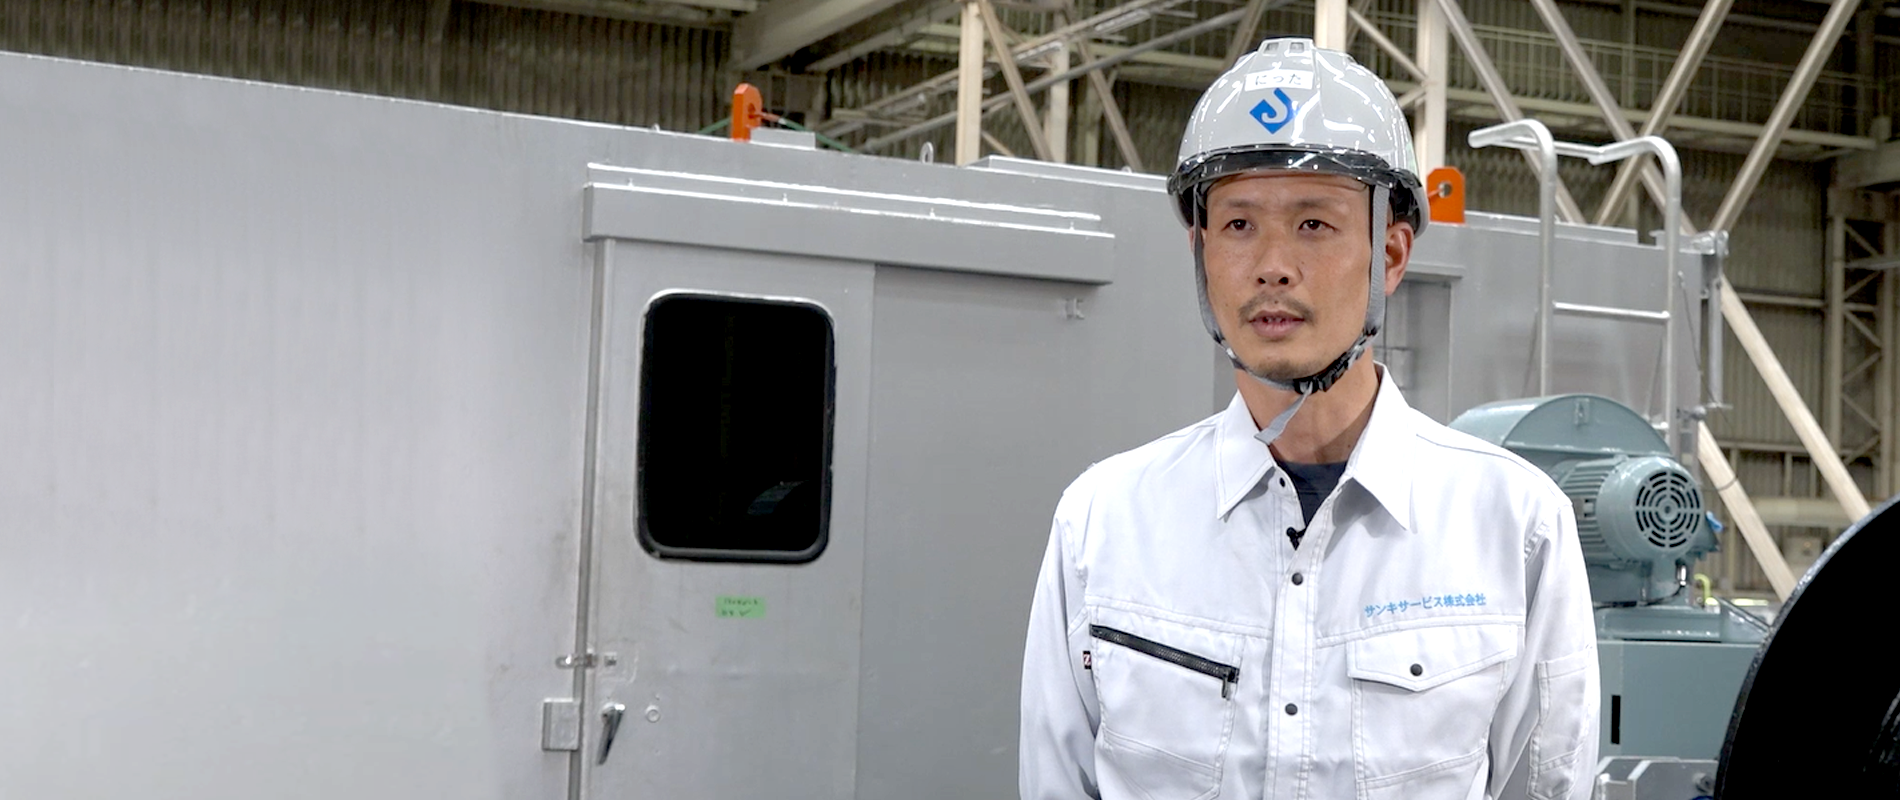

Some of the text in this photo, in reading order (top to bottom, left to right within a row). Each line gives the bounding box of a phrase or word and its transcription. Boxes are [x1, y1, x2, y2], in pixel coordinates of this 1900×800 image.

[1255, 73, 1302, 86] にった
[1364, 593, 1487, 618] サンキサービス株式会社
